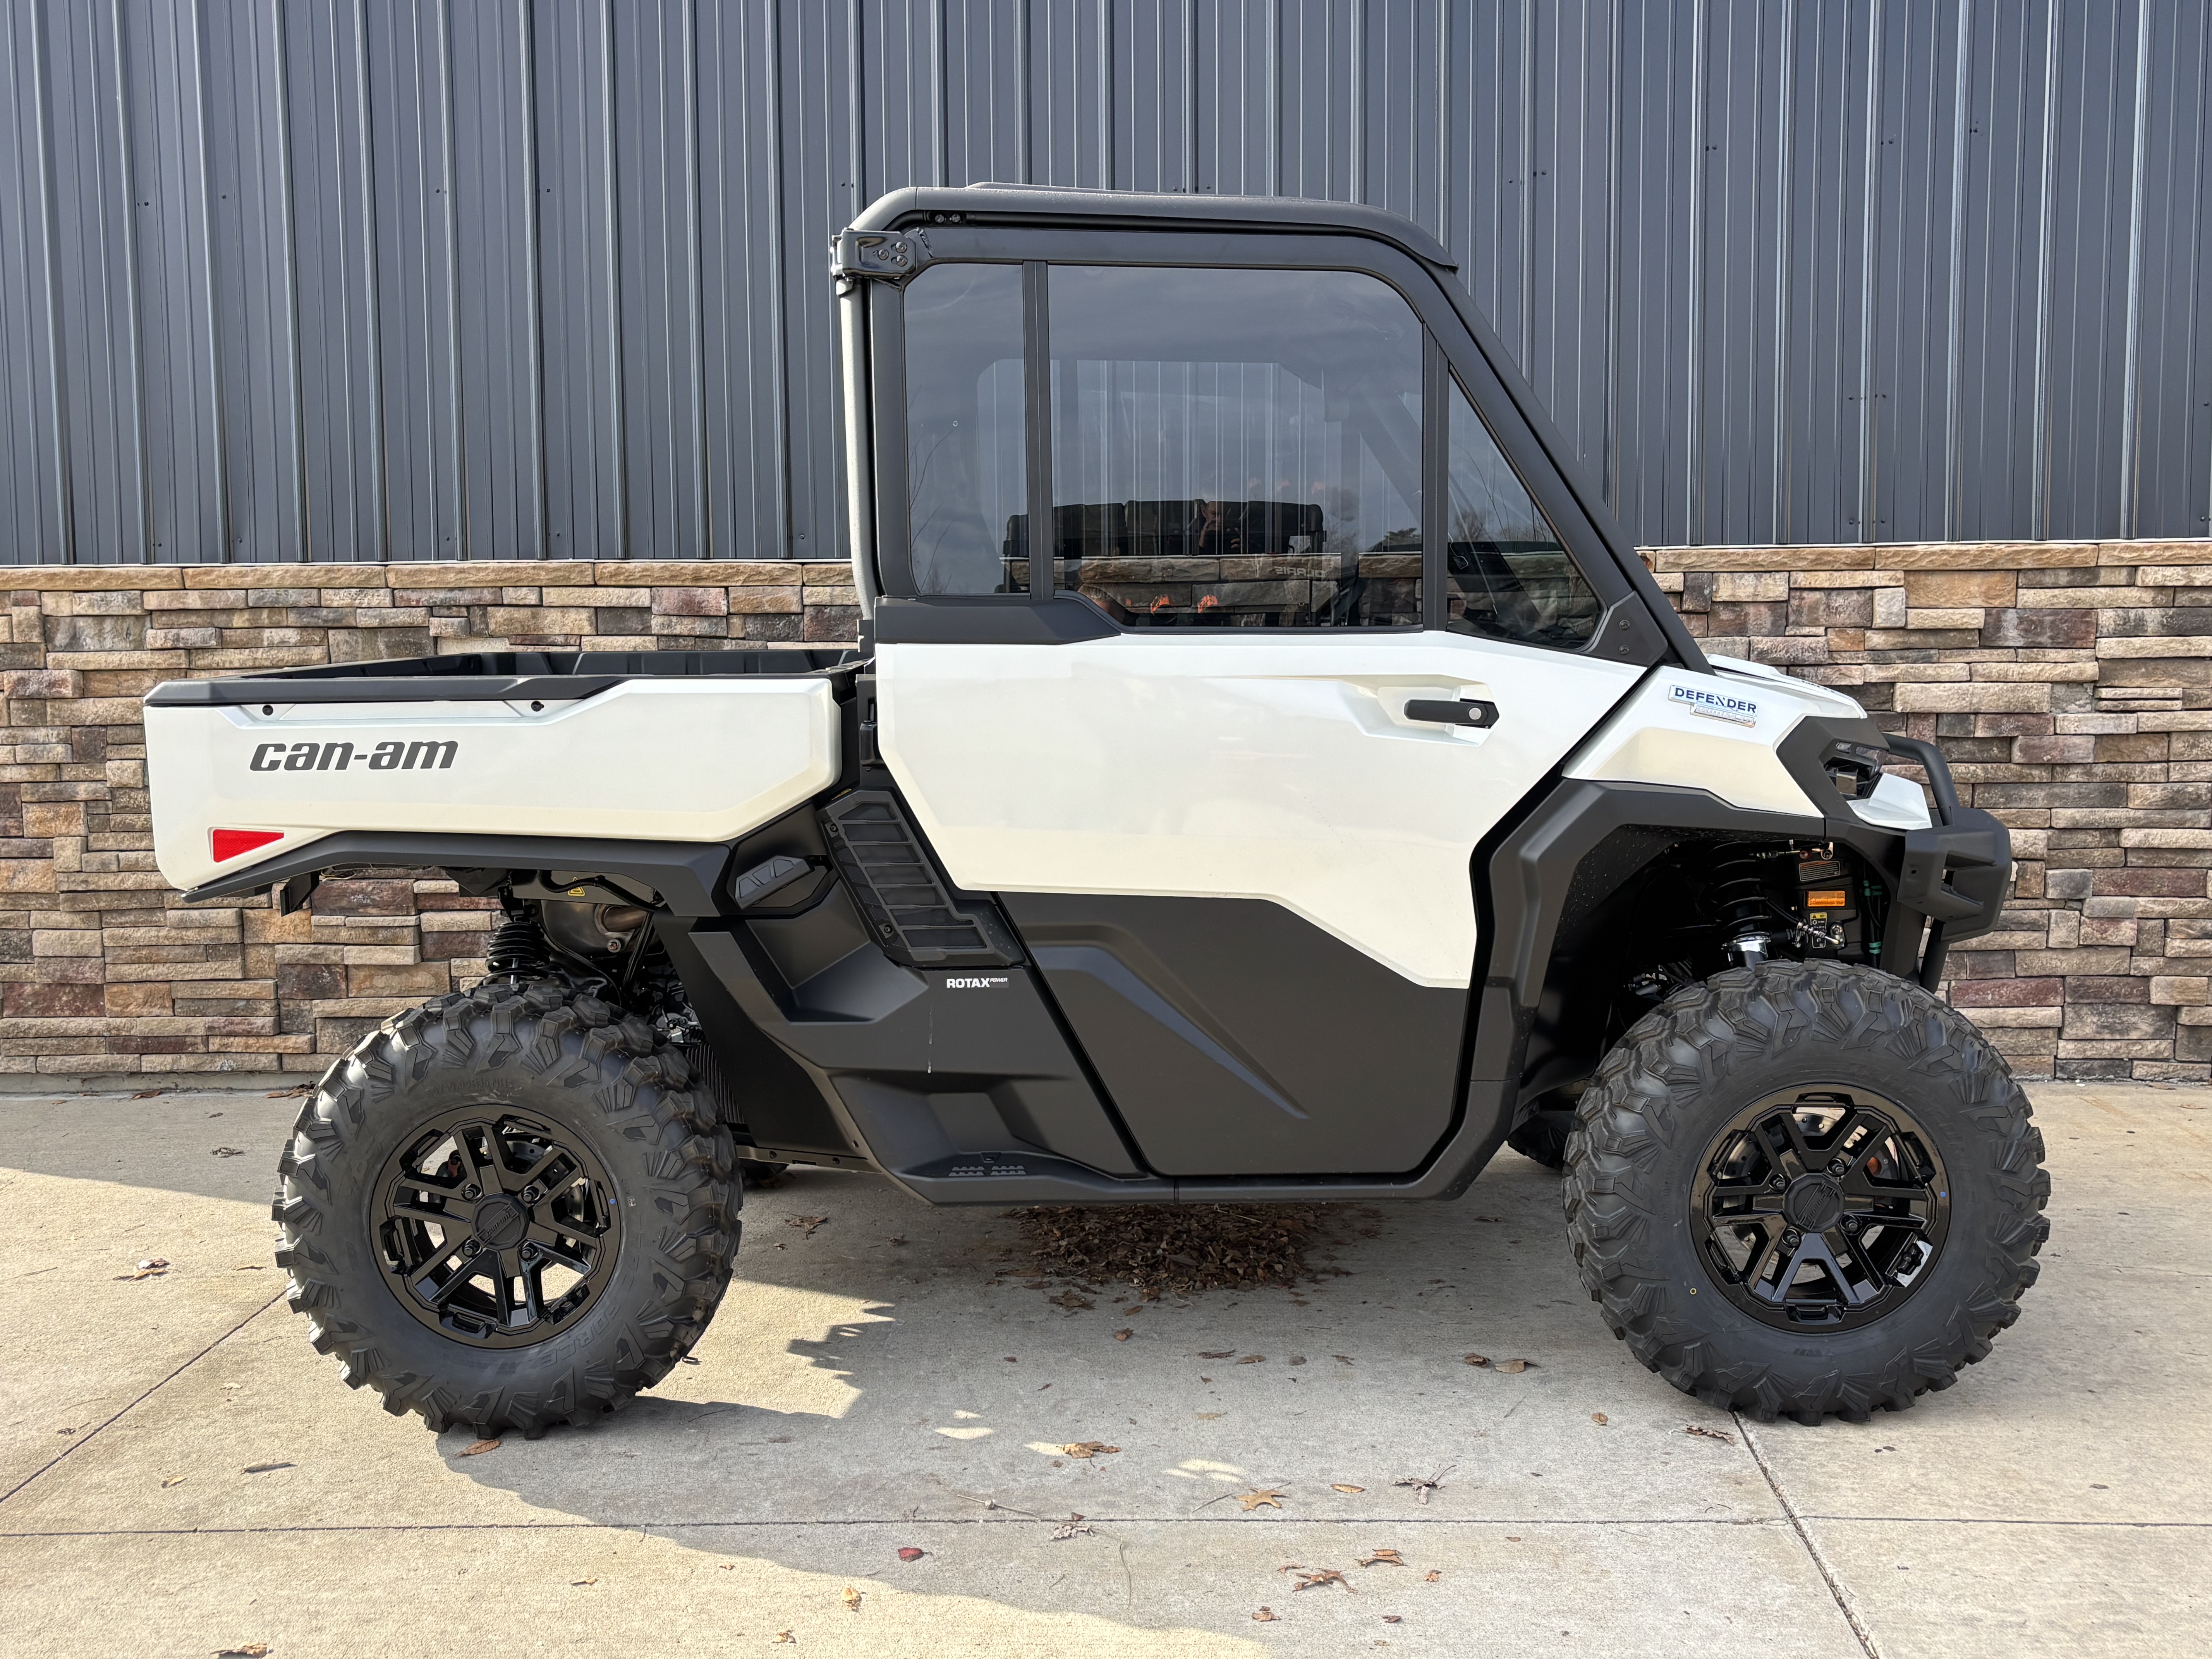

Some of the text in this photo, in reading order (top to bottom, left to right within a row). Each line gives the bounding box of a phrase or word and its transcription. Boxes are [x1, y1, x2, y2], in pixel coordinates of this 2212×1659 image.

[1674, 687, 1757, 713] DEFENDER
[249, 740, 459, 771] can-am
[946, 977, 990, 988] ROTAX
